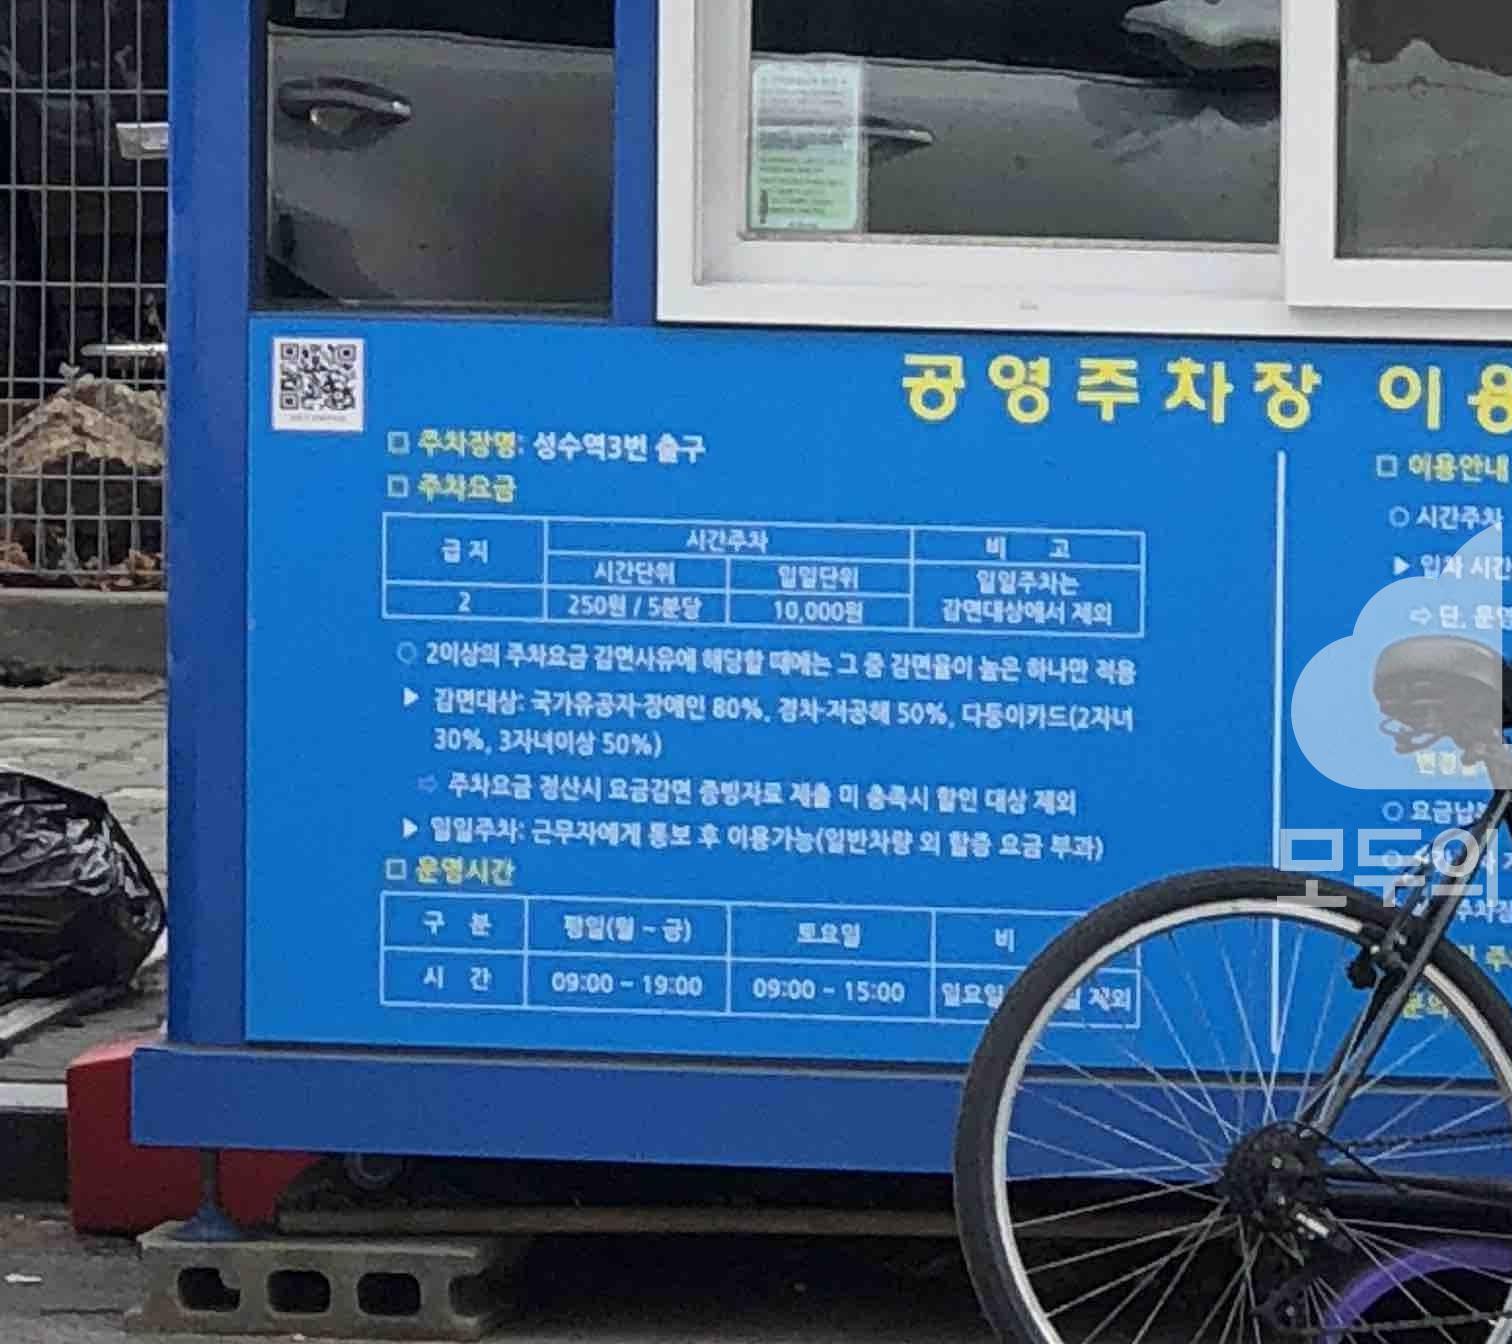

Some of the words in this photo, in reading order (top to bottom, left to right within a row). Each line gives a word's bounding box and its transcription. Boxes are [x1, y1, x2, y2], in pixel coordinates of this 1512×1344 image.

[901, 353, 1322, 430] 공영주차장
[532, 431, 648, 463] 성수역3번
[655, 432, 706, 464] 출구
[1408, 453, 1511, 484] 이용안내
[418, 472, 517, 504] 주차요금
[1416, 505, 1504, 532] 시간주차
[686, 528, 769, 555] 시간주차
[593, 559, 677, 586] 시간단위
[457, 591, 471, 613] 2
[941, 598, 1066, 625] 감면대상에서
[426, 641, 500, 669] 2이상의
[507, 643, 589, 671] 주차요금
[1026, 657, 1090, 685] 하나만
[499, 728, 597, 757] 3자녀이상
[448, 771, 533, 800] 주차요금
[935, 786, 979, 815] 할인
[984, 787, 1028, 816] 대상
[999, 832, 1044, 861] 요금
[796, 921, 862, 949] 토요일
[551, 970, 614, 994] 09:00
[643, 973, 703, 997] 19:00
[751, 976, 816, 1001] 09:00
[844, 979, 905, 1003] 15:00
